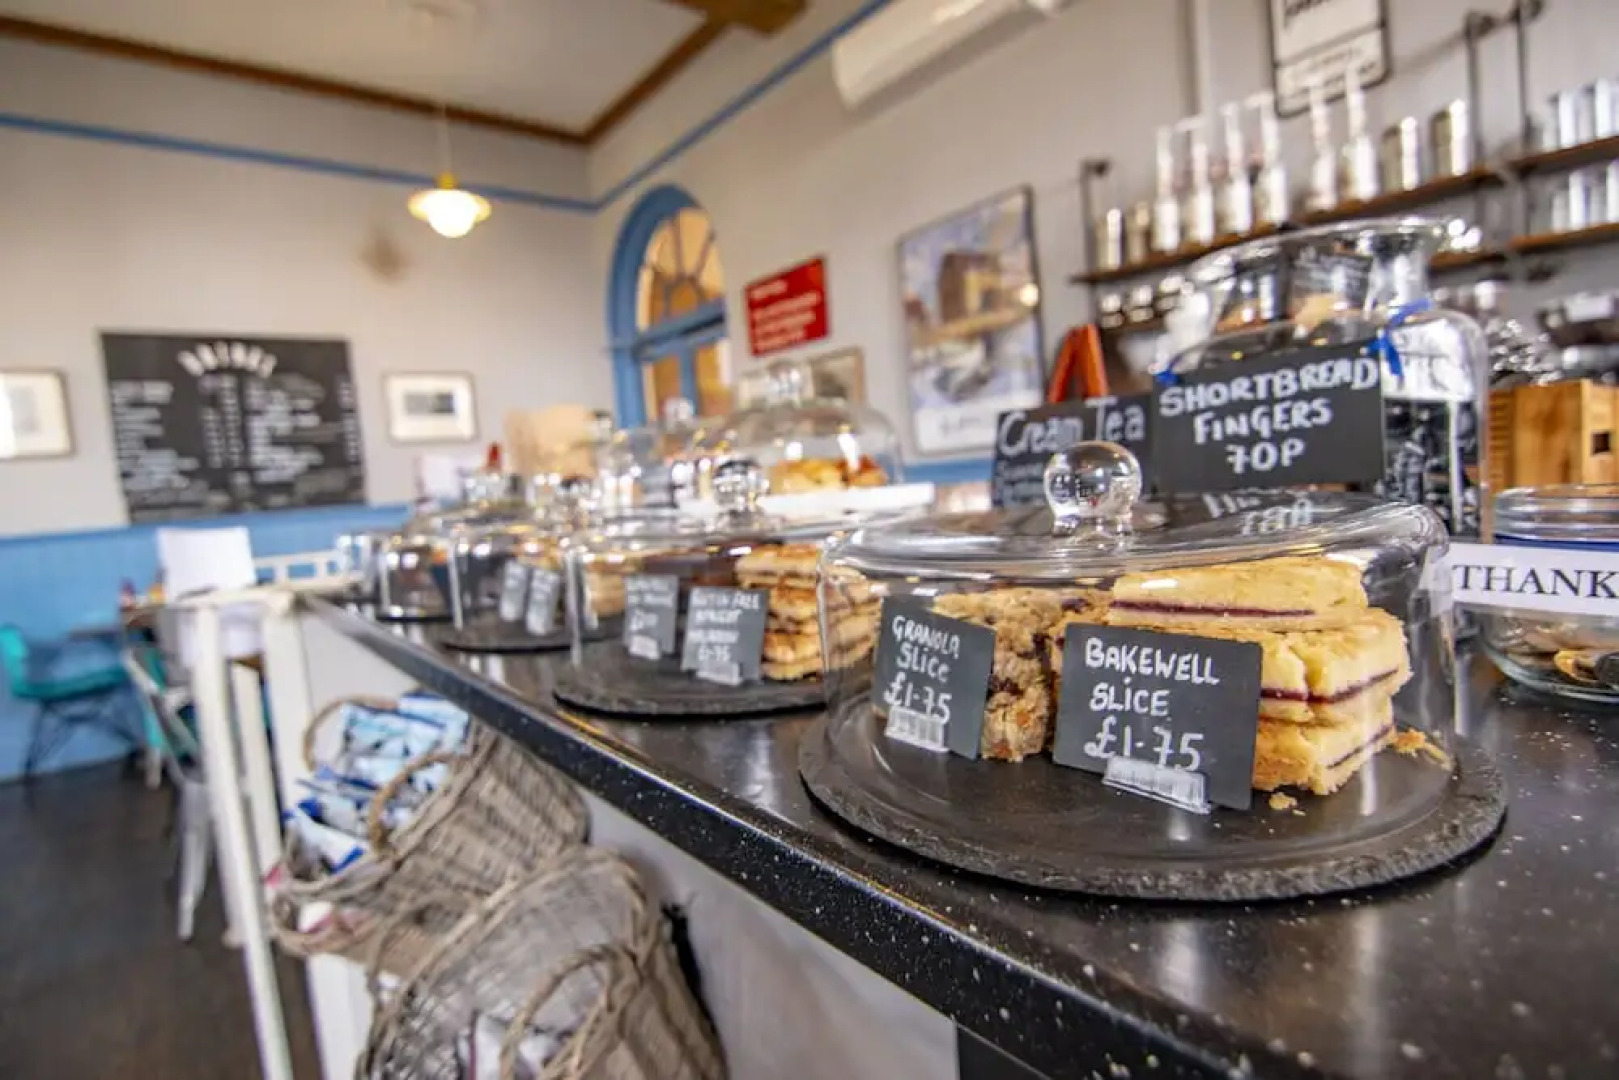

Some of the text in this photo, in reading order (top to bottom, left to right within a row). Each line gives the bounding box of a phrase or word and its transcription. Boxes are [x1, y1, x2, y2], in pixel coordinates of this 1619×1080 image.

[1159, 357, 1379, 417] SHORTBREAD
[1084, 395, 1146, 441] Tea
[1193, 397, 1333, 445] FINGERS
[892, 614, 961, 659] GRANOLA
[1084, 637, 1220, 685] BAKEWELL
